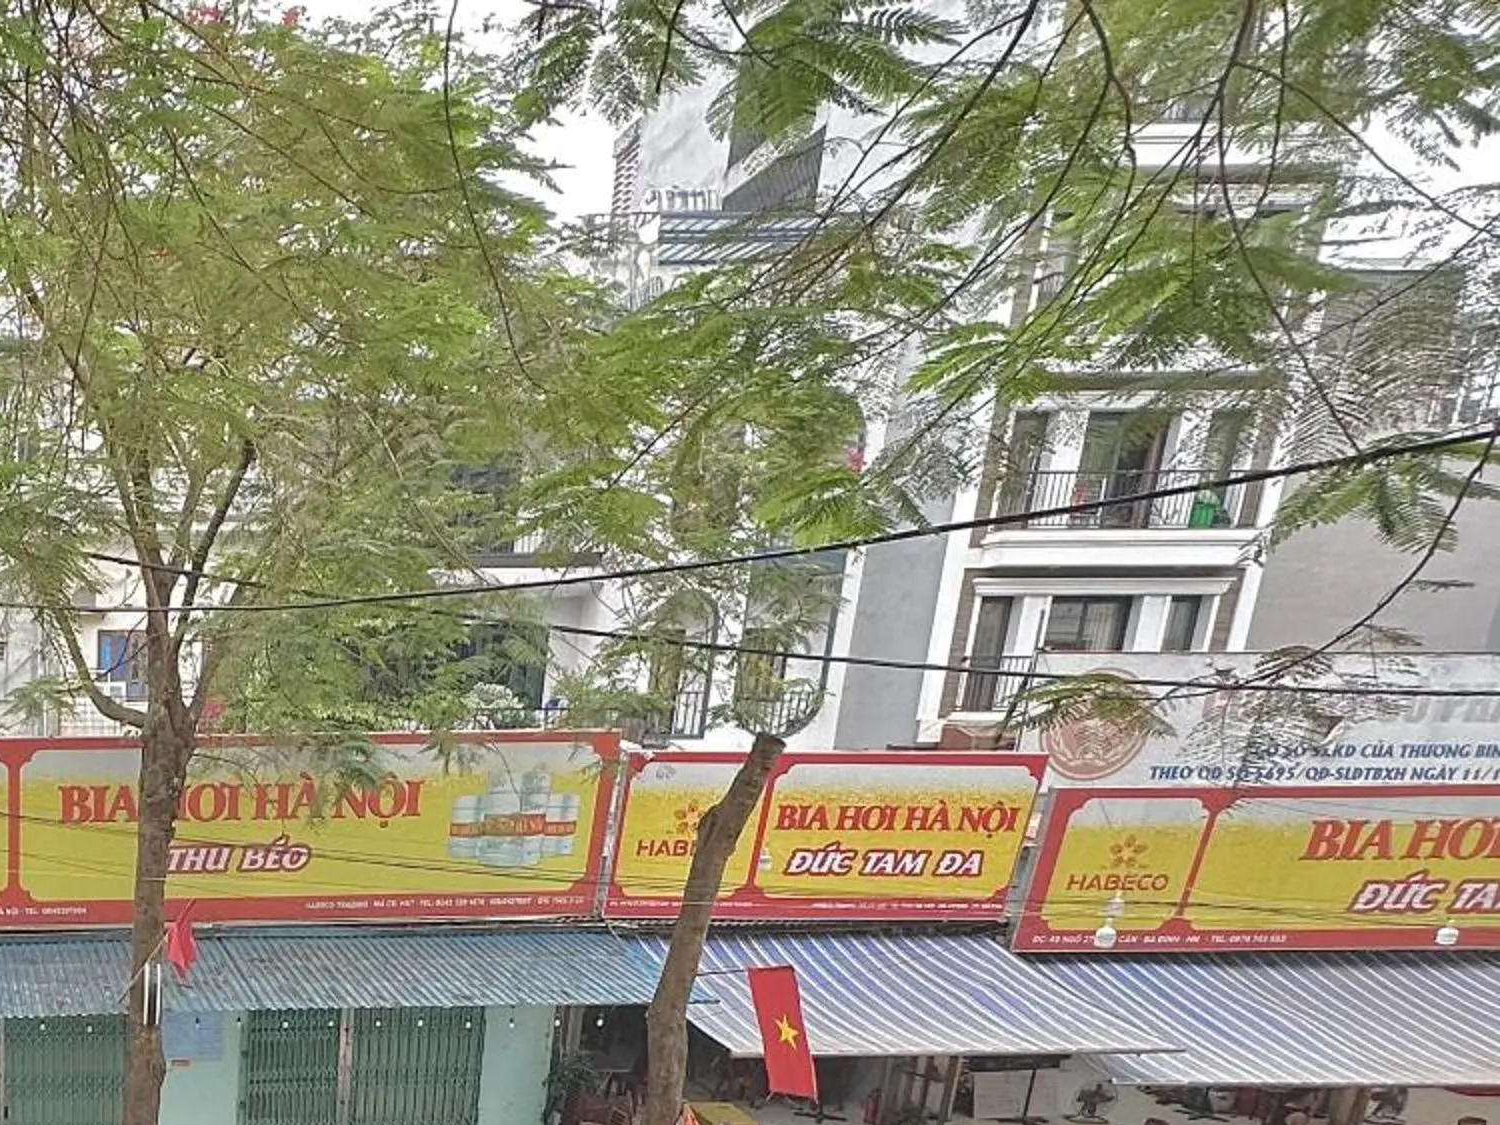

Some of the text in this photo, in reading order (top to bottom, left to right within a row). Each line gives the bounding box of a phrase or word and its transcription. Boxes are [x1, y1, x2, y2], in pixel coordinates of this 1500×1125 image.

[1150, 765, 1192, 780] THEO
[58, 784, 138, 825] BIA
[252, 772, 324, 820] HÀ
[330, 772, 426, 829] NỘI
[774, 804, 829, 831] BIA
[902, 799, 950, 832] HÀ
[957, 800, 1022, 838] NỘI
[168, 834, 310, 872] THU BÉO
[636, 839, 697, 857] HAB
[1299, 819, 1393, 860] BIA
[786, 843, 982, 875] ĐỨC TAM ĐA
[1065, 873, 1170, 891] HABECO
[1352, 872, 1500, 910] ĐỨC TA
